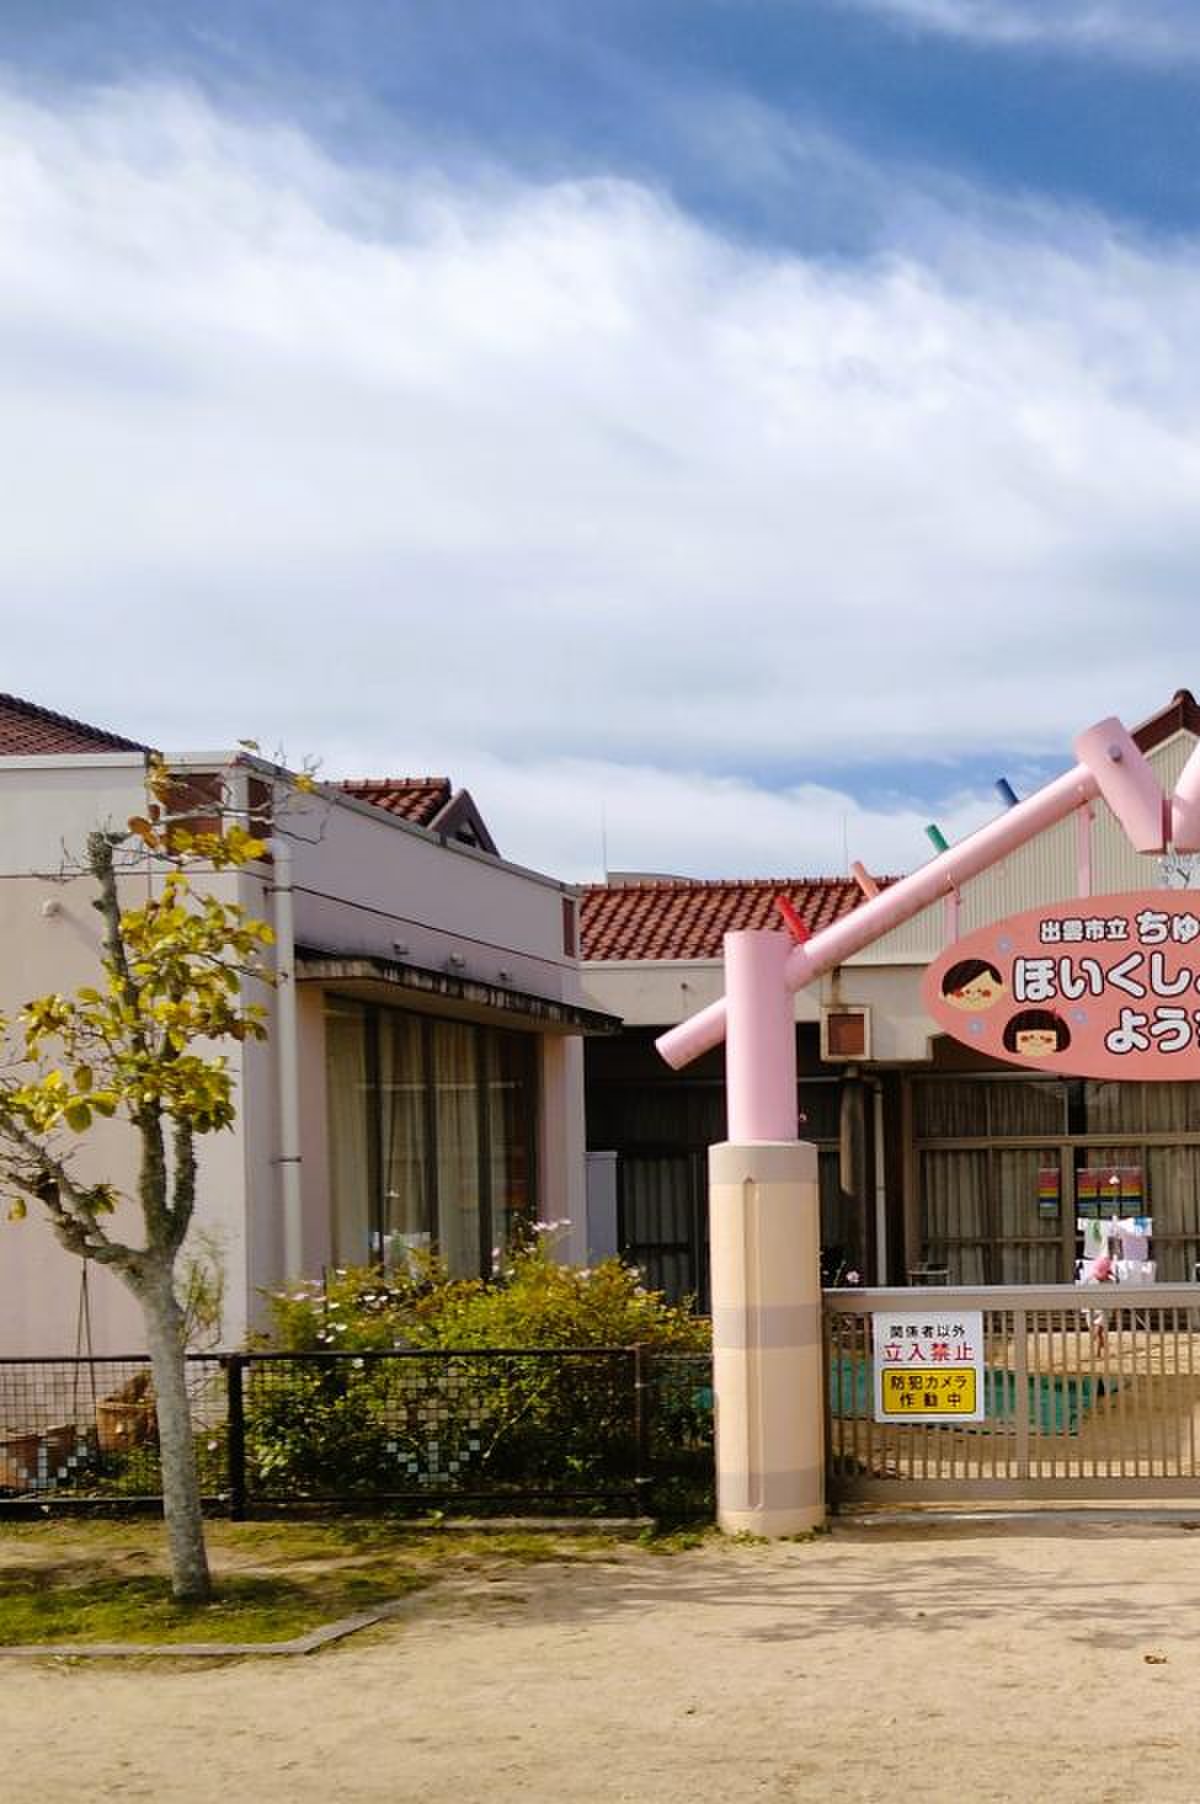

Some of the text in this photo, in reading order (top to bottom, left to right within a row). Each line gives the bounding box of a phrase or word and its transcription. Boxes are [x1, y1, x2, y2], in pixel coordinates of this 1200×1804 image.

[1040, 917, 1130, 943] 出雲市立
[889, 1323, 966, 1339] 関係者以外
[883, 1341, 976, 1362] 立入禁止
[890, 1375, 968, 1391] 防犯カメラ
[899, 1392, 962, 1408] 作動中
